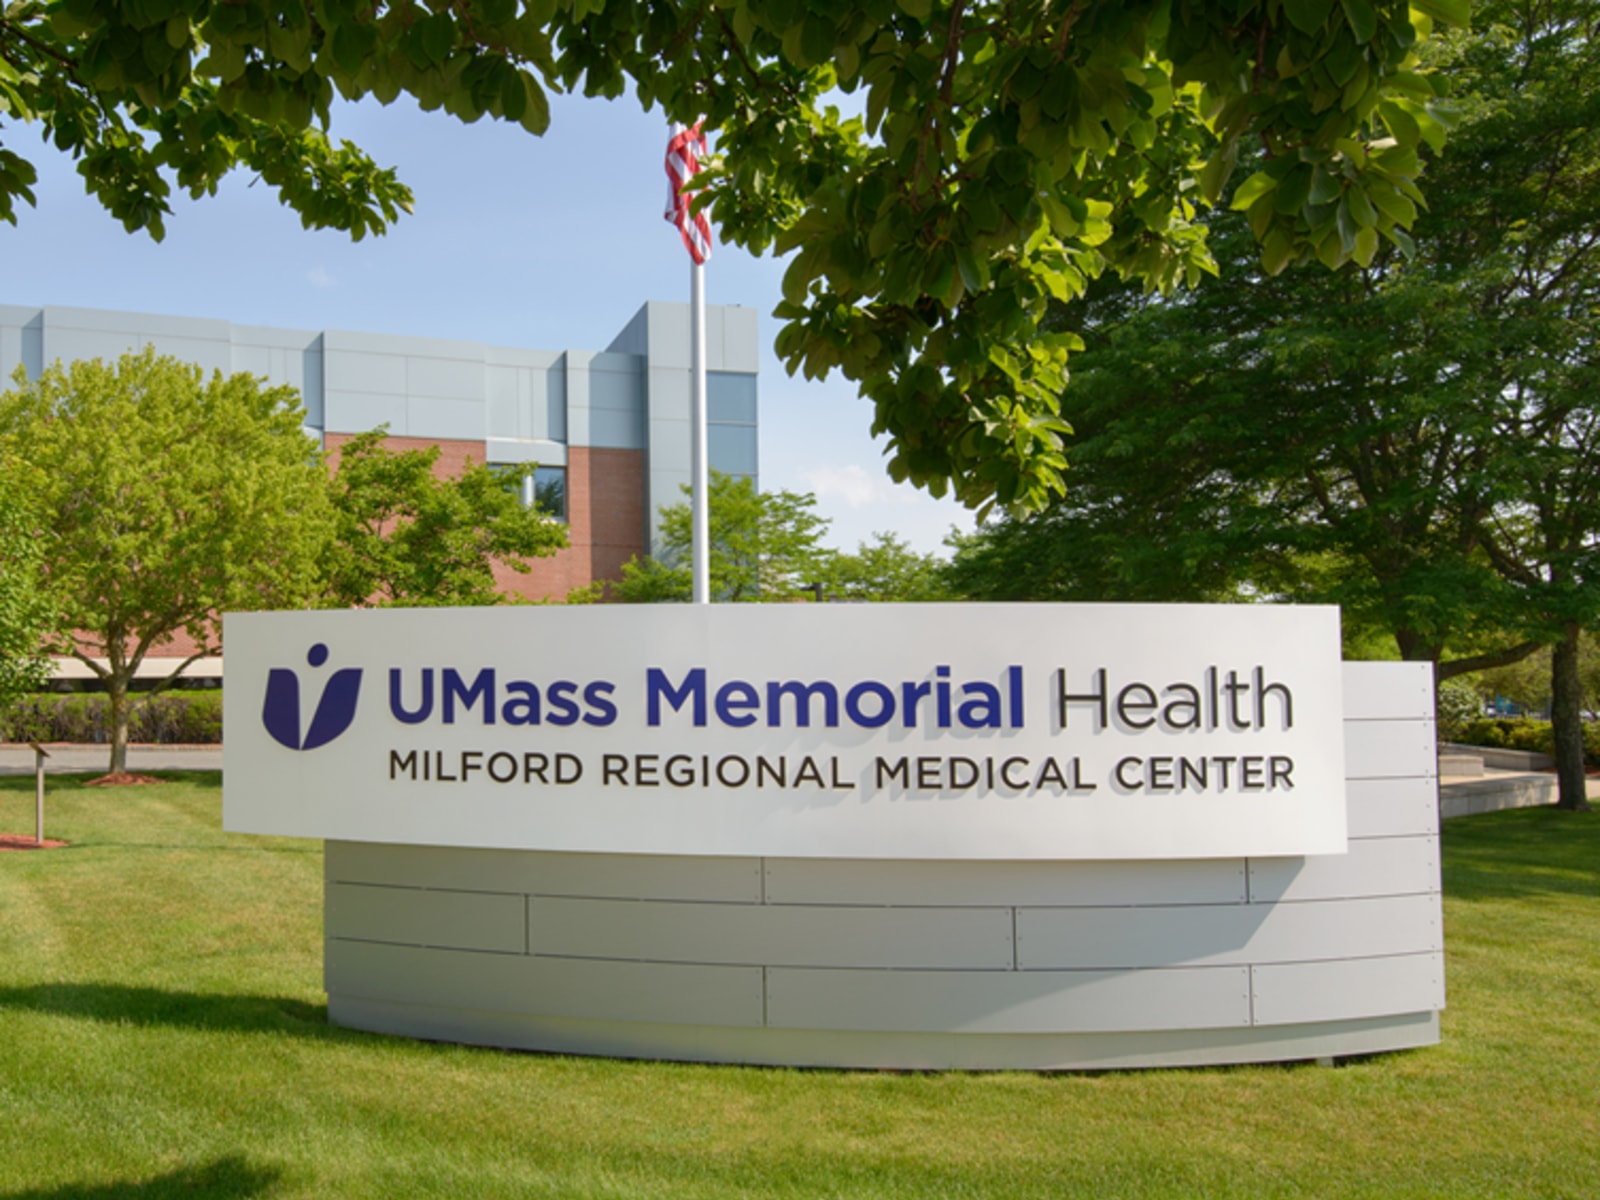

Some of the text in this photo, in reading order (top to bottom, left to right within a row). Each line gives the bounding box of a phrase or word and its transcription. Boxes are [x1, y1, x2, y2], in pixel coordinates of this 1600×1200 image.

[389, 665, 1293, 729] UMass Memorial Health
[390, 750, 1295, 790] MILFORD REGIONAL MEDICAL CENTER
